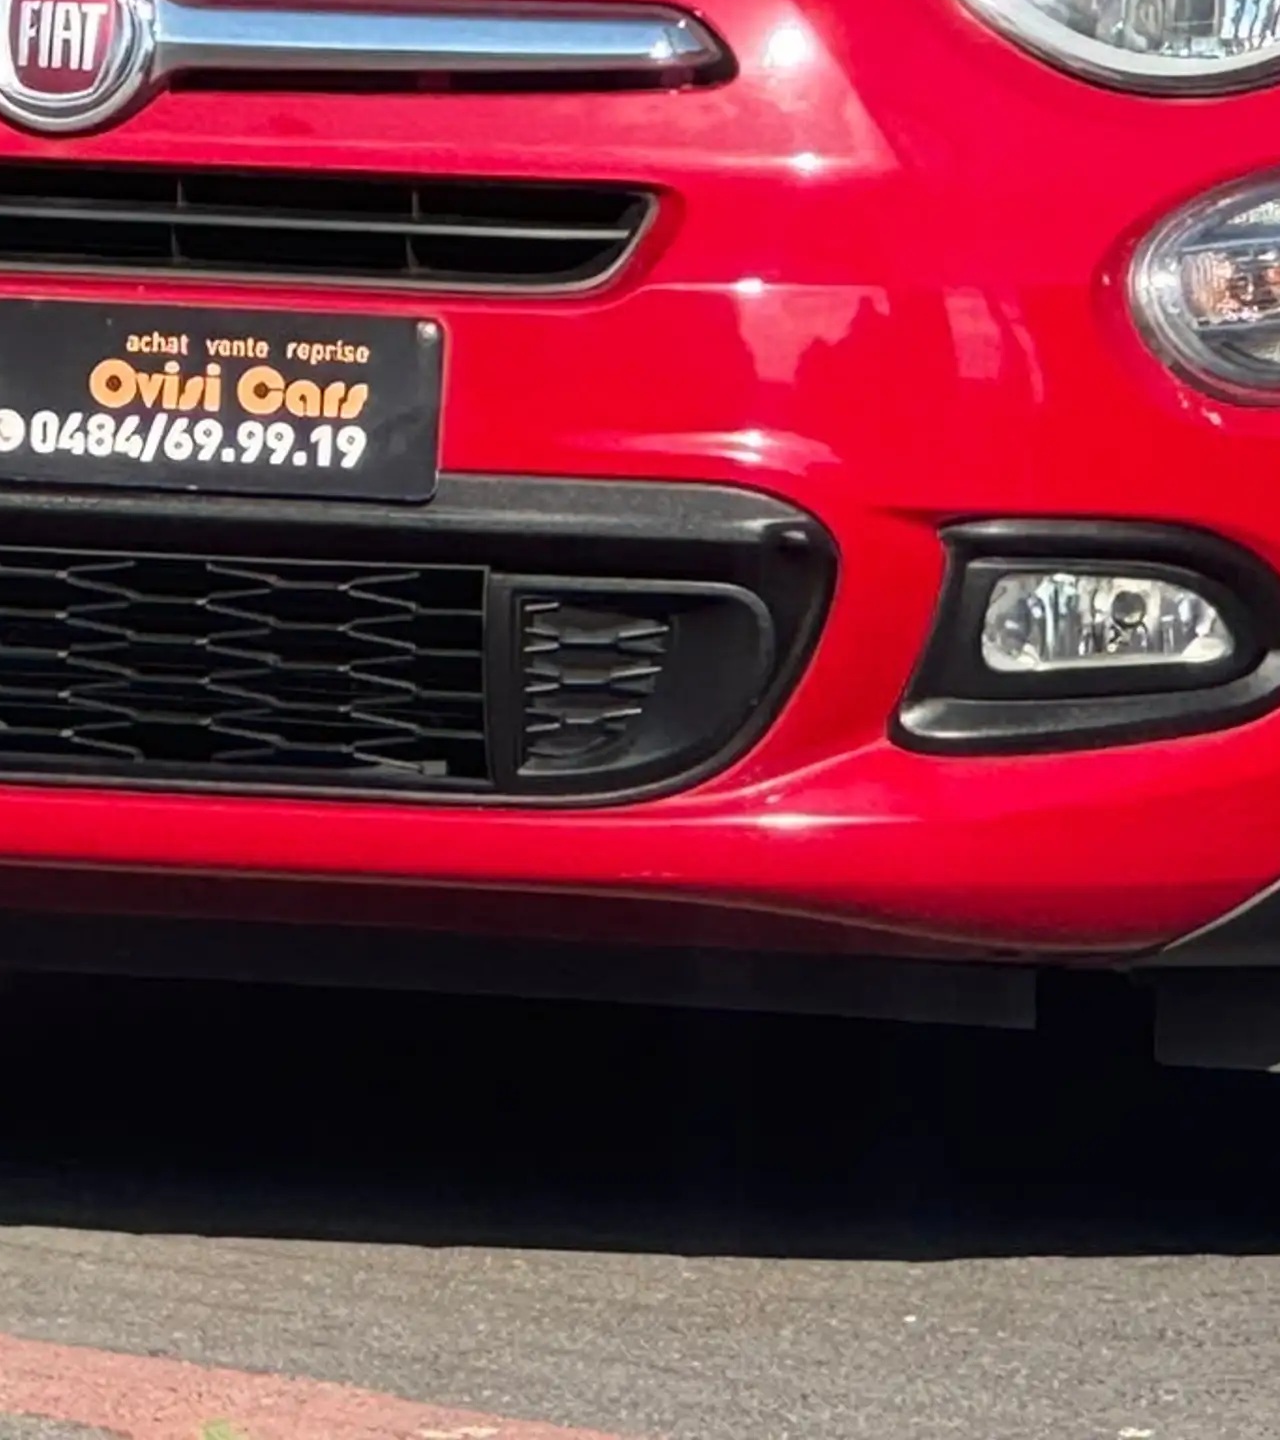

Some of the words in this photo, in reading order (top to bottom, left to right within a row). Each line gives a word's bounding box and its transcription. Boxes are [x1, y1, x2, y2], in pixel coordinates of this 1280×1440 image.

[18, 0, 109, 71] FIAT
[125, 331, 190, 355] achat
[205, 337, 270, 358] vente
[285, 340, 370, 365] reprise
[89, 358, 222, 412] Ovisi
[236, 365, 369, 419] Cars
[30, 409, 368, 469] 0484/69.99.19
